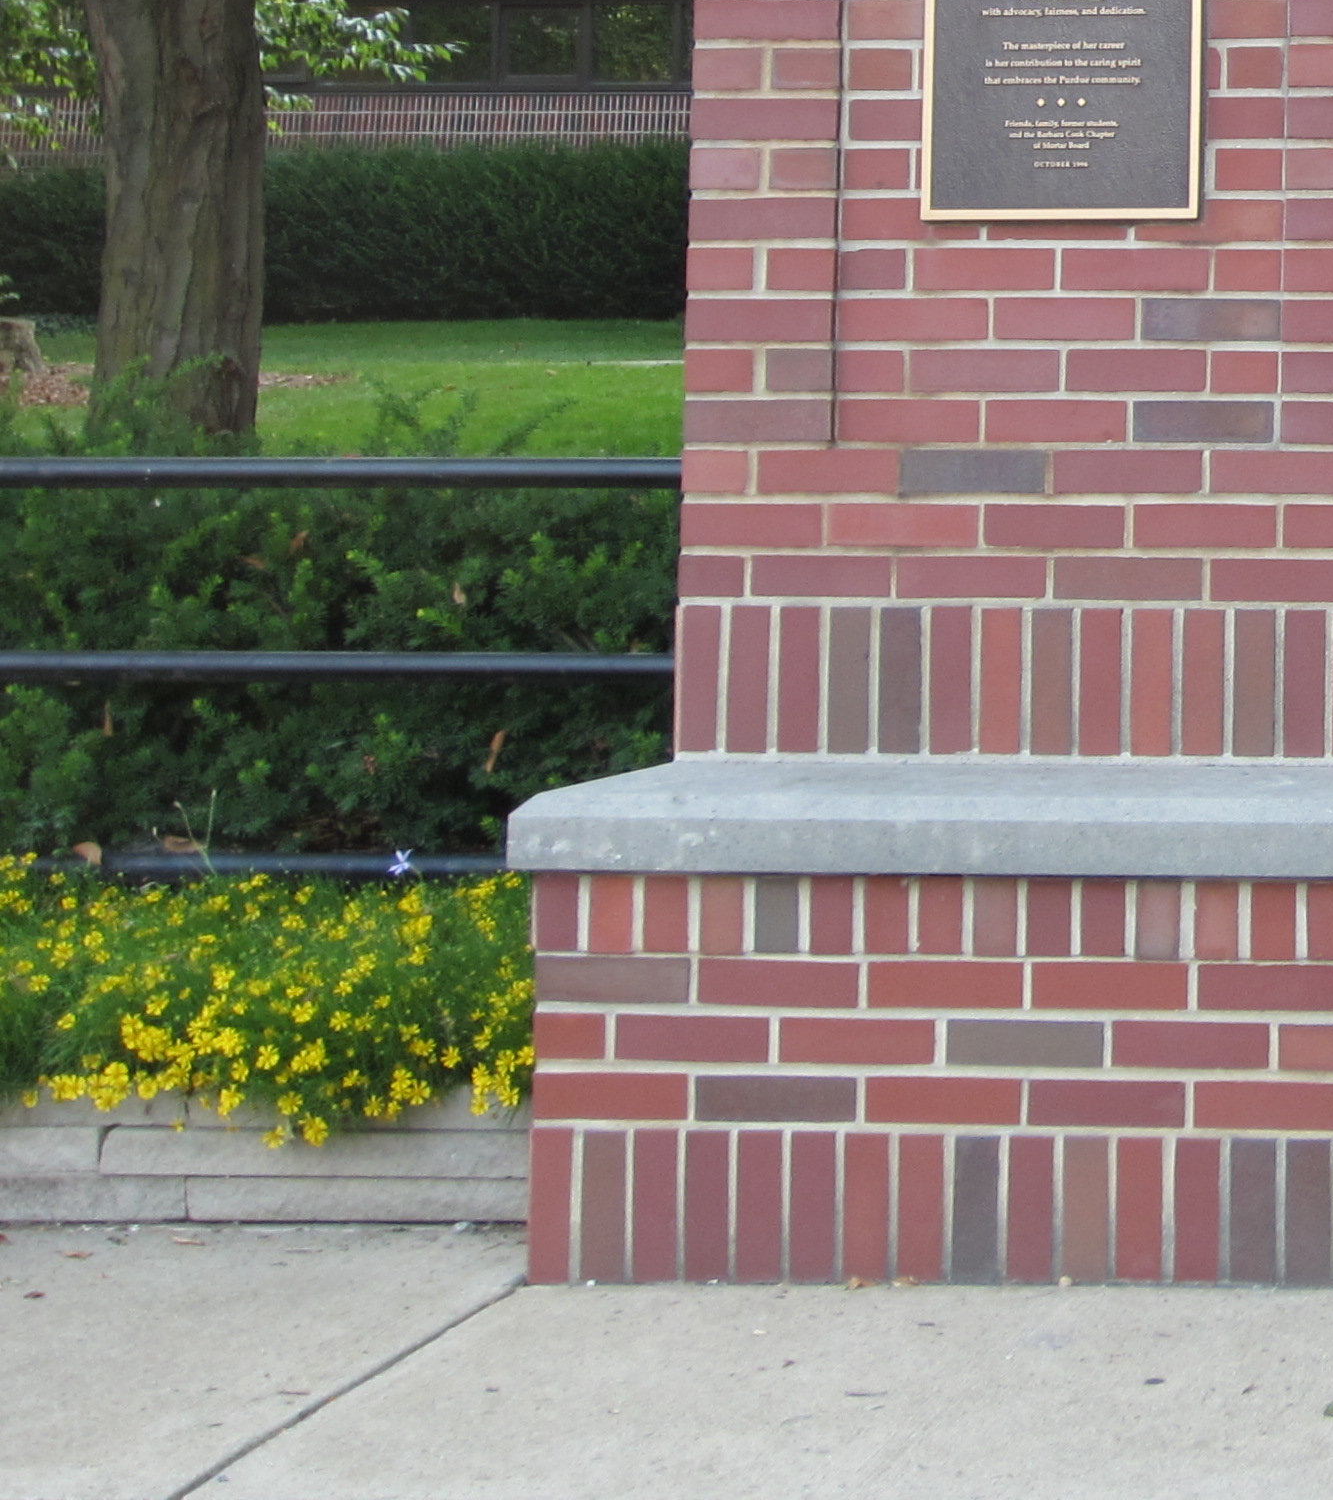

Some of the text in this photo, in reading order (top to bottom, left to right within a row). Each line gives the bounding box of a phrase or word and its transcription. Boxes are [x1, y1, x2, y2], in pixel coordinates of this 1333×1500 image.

[982, 8, 1001, 16] with
[1003, 8, 1042, 17] advocacy,
[1082, 7, 1097, 15] and
[1100, 6, 1146, 15] dedication.
[1003, 42, 1019, 50] The
[1021, 42, 1070, 51] masterpiece
[1072, 41, 1082, 49] of
[1083, 41, 1097, 49] her
[986, 58, 1141, 68] is her contribution to the caring spirit
[1044, 76, 1057, 84] the
[1059, 76, 1089, 84] Purdue
[1086, 131, 1115, 139] Chapter
